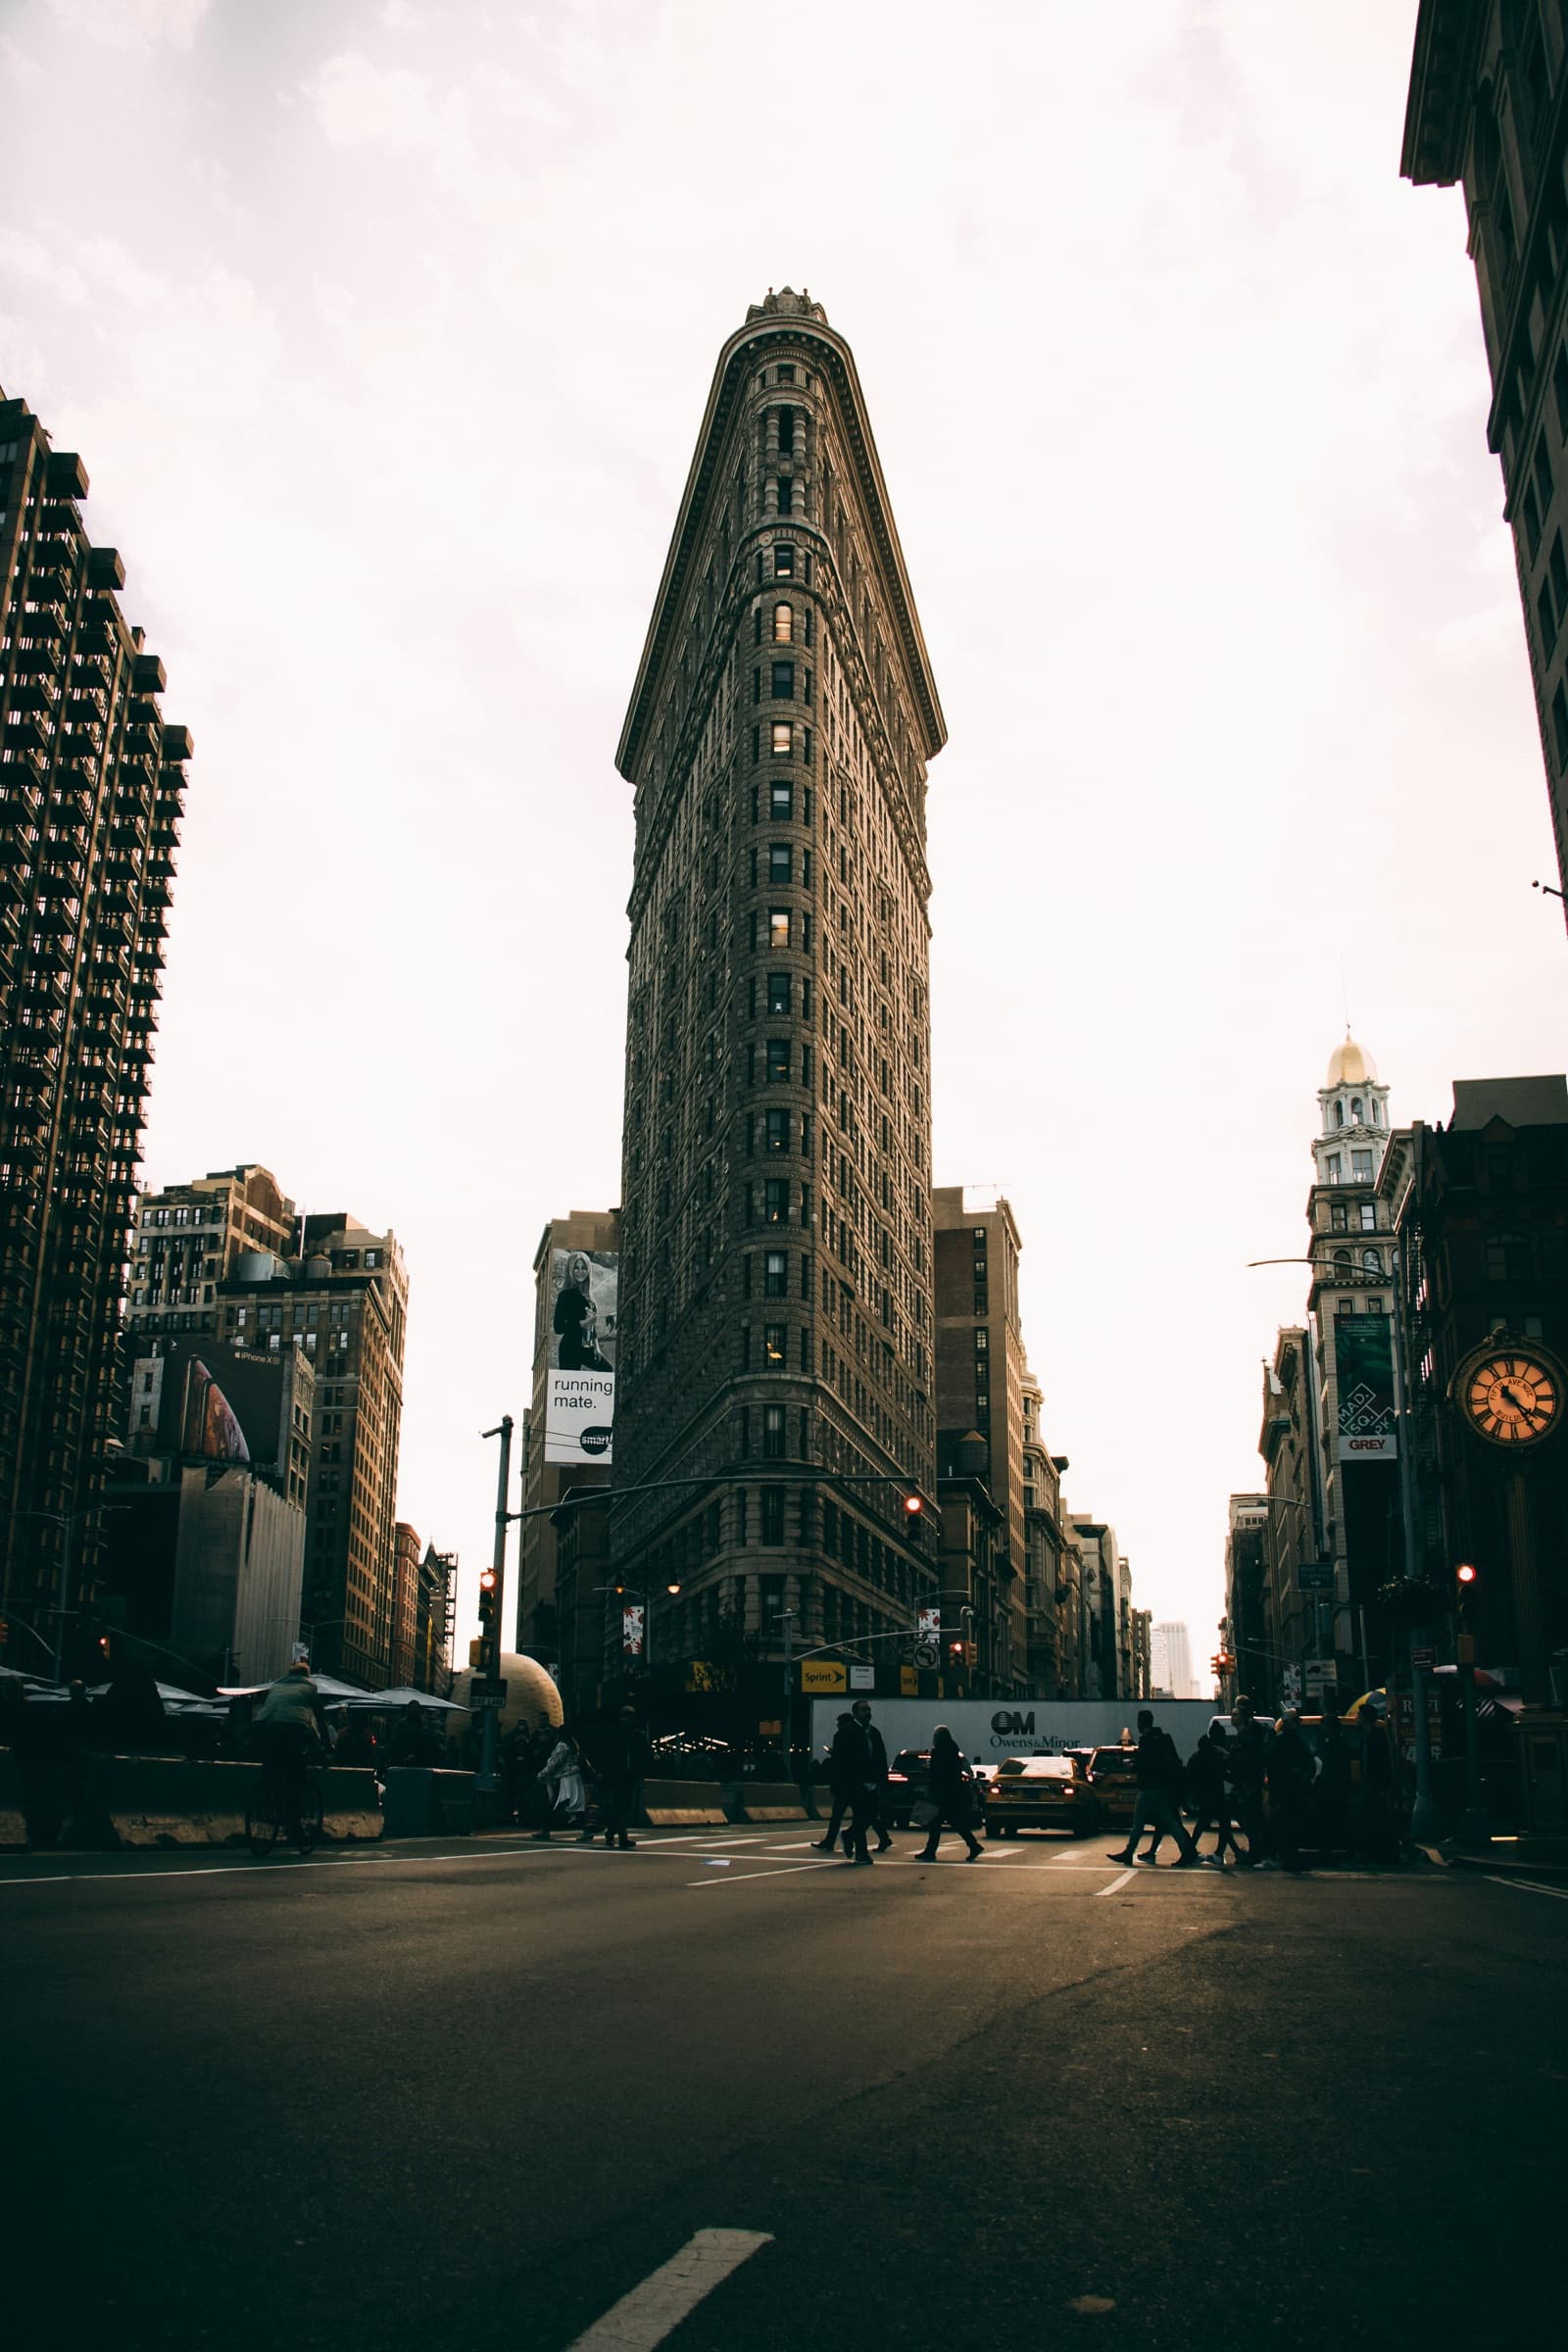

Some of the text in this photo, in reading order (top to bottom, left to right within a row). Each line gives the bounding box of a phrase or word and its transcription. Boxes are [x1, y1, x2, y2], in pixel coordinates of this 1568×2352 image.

[555, 1378, 612, 1396] running
[1508, 1379, 1534, 1397] AVENUE
[554, 1396, 597, 1409] mate.
[1348, 1440, 1386, 1450] GREY
[805, 1672, 831, 1683] Sprint
